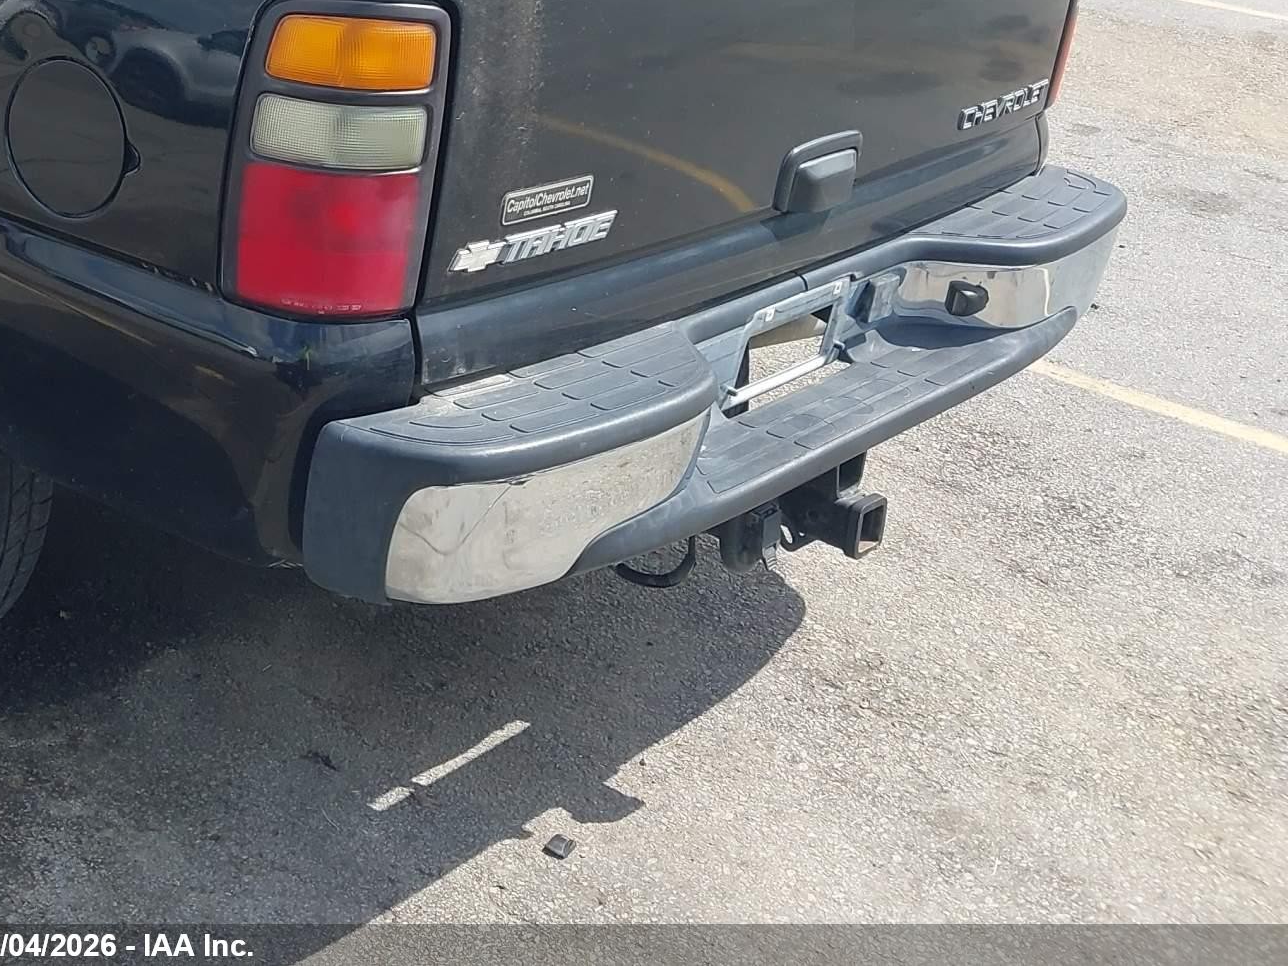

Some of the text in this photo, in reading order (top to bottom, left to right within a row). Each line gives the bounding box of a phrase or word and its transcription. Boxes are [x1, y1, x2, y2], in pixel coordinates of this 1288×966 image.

[958, 78, 1050, 130] CHEVROLET
[506, 182, 590, 214] CapitolChevrolet.net
[500, 210, 619, 264] TAHOE
